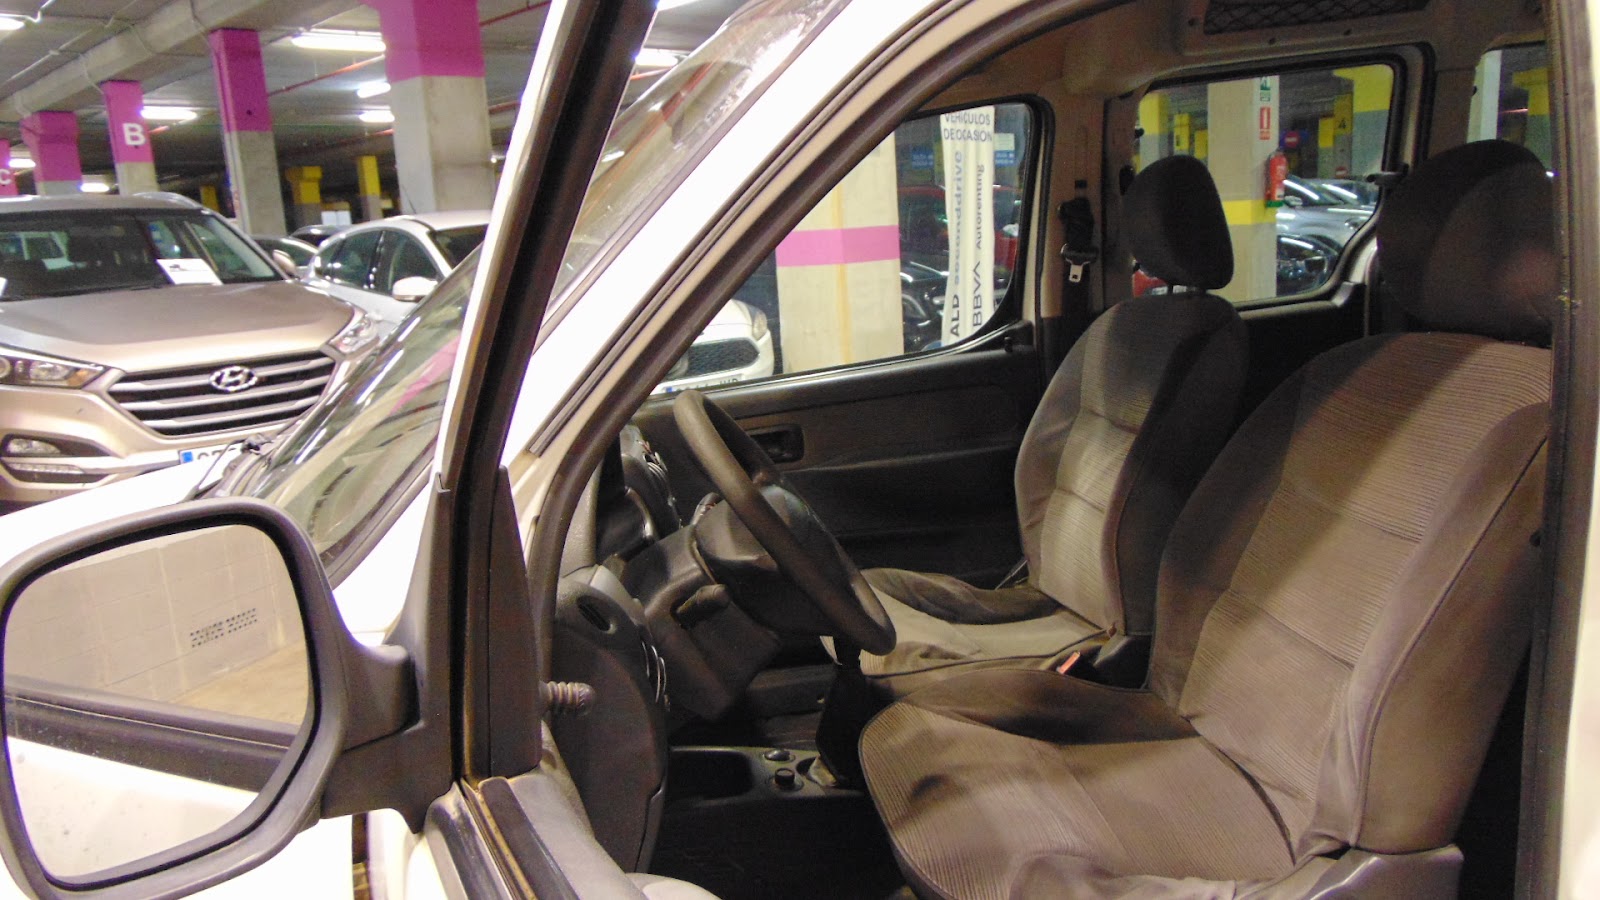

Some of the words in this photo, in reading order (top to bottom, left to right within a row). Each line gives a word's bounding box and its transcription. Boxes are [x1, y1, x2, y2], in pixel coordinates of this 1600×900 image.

[122, 122, 146, 146] B
[0, 168, 12, 185] C
[976, 164, 985, 250] Autorenting
[972, 260, 982, 327] BBVA
[949, 294, 960, 337] ALD
